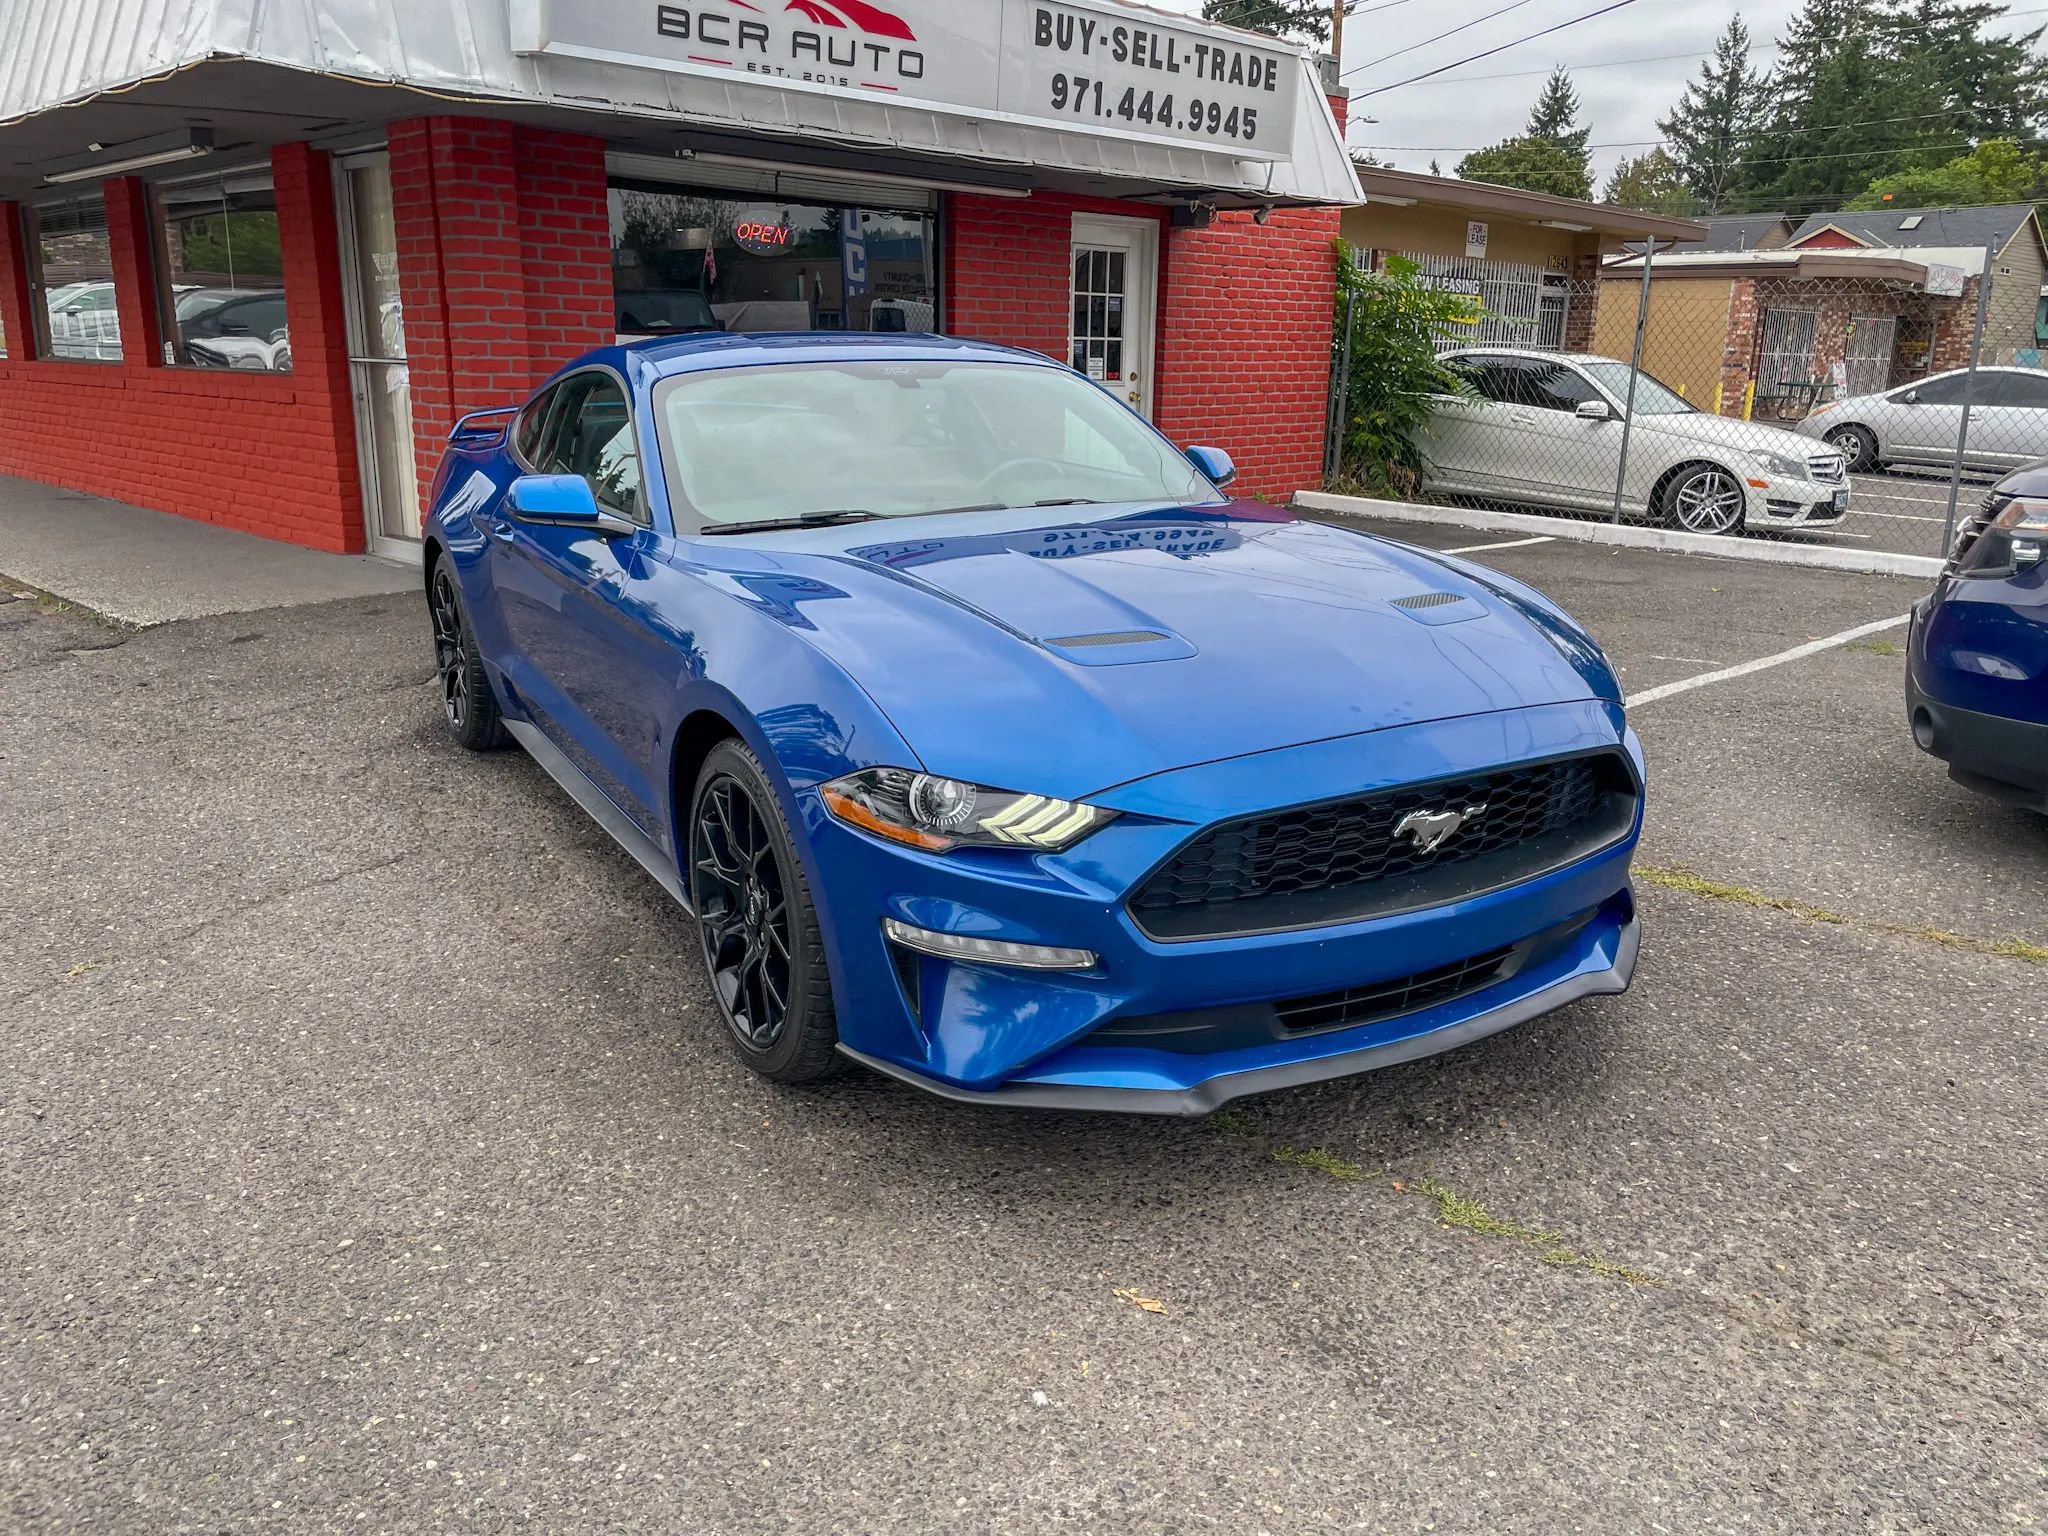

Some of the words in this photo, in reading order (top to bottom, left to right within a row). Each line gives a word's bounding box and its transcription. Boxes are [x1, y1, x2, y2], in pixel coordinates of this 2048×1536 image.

[657, 4, 769, 53] BCR
[792, 30, 924, 79] AUTO
[1034, 8, 1278, 92] BUY-SELL-TRADE
[747, 62, 791, 79] EST.
[803, 72, 849, 87] 2015
[1050, 73, 1258, 140] 971.444.9945
[737, 223, 789, 245] OPEN
[1468, 233, 1487, 246] LEASE
[1436, 276, 1480, 294] LEASING
